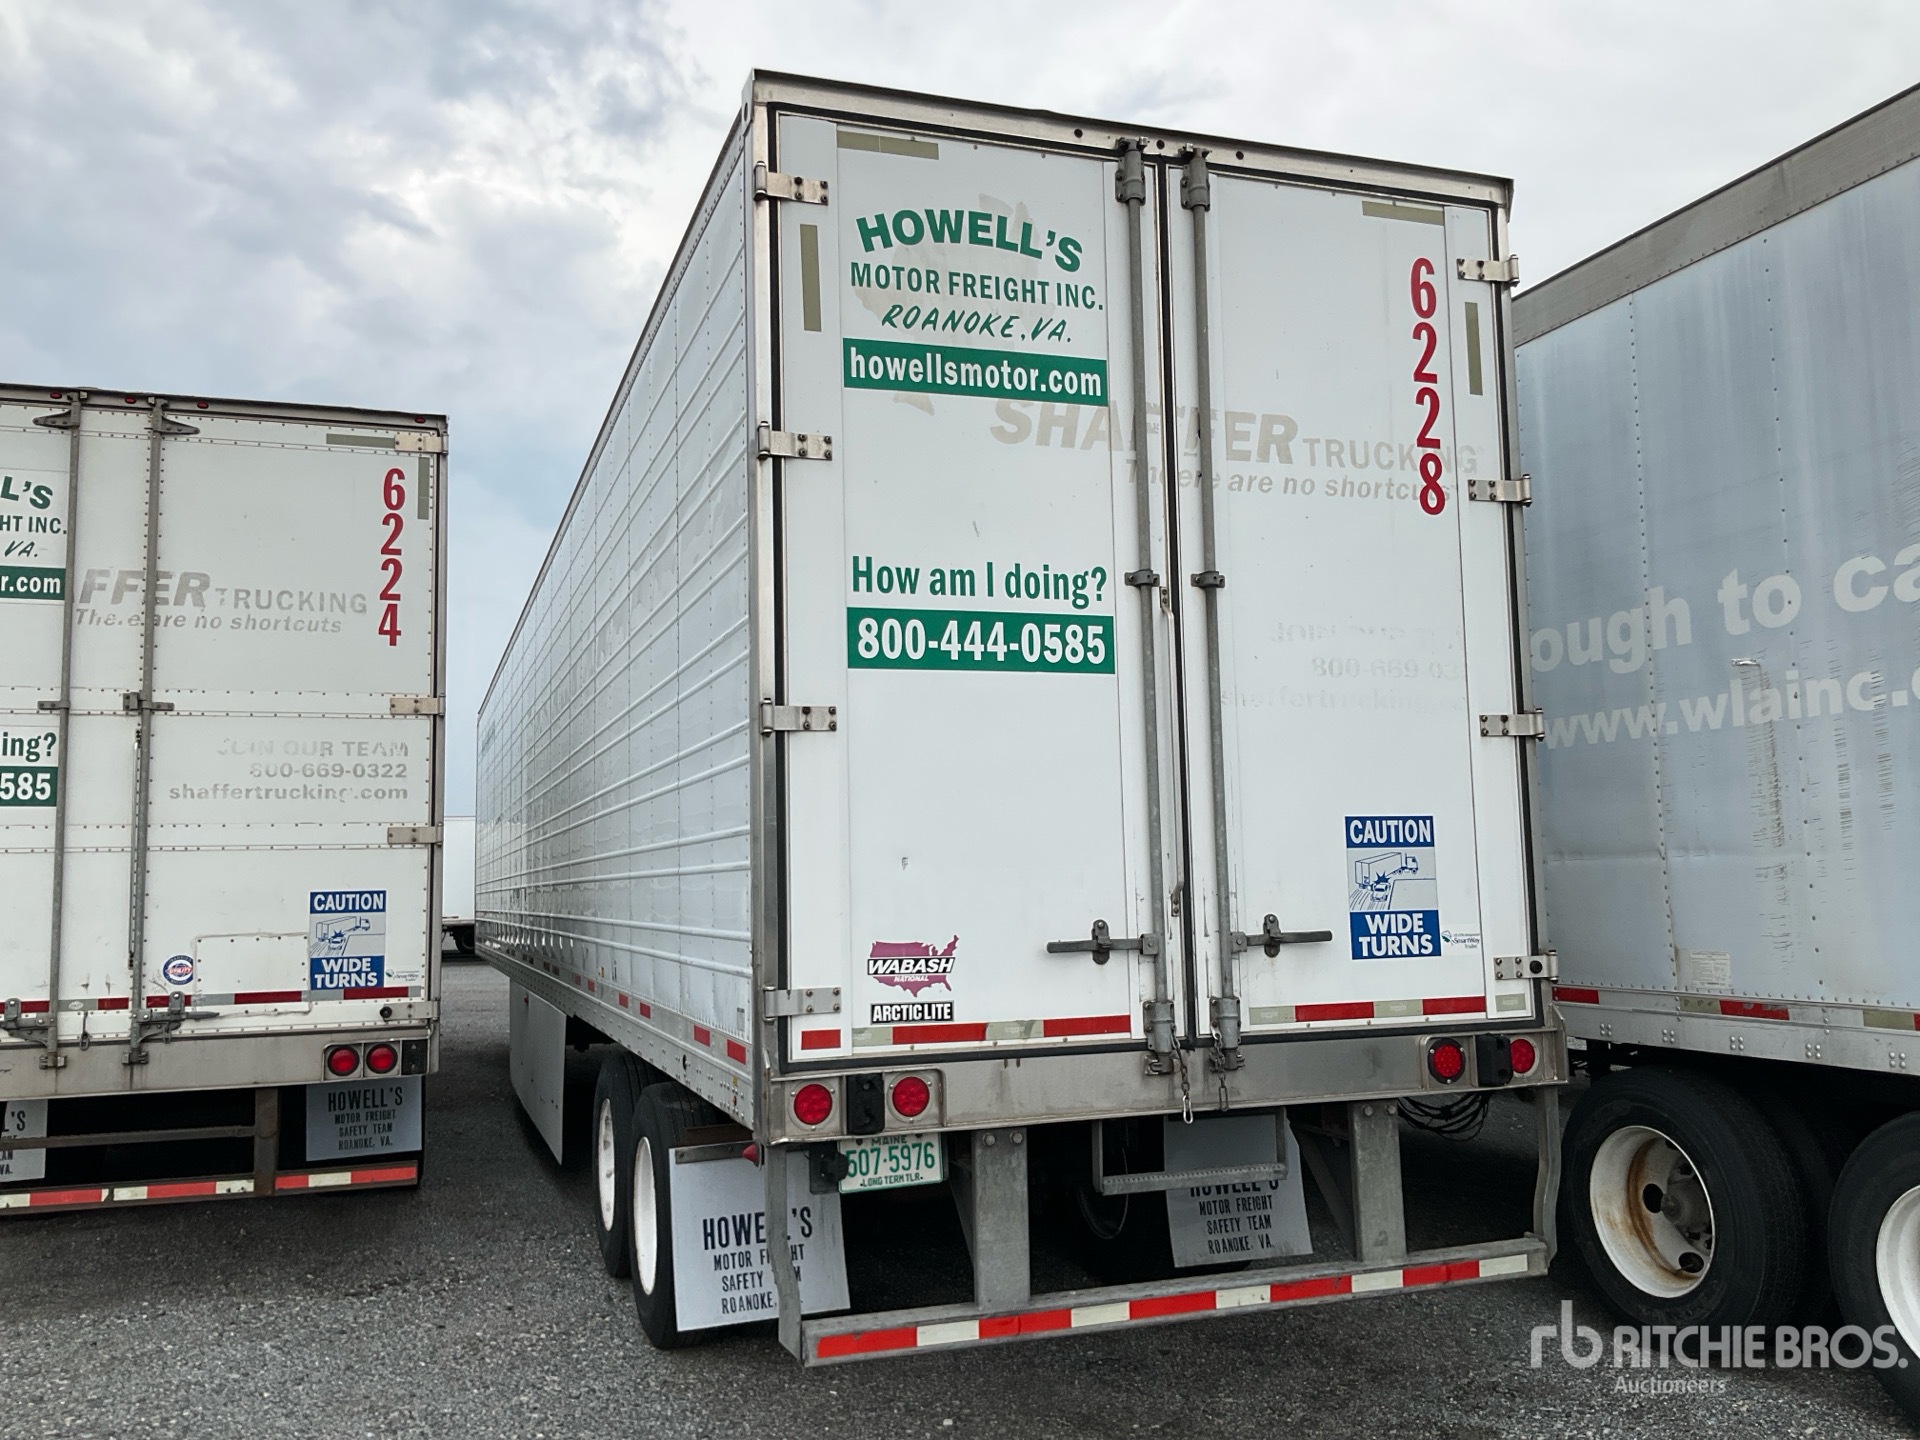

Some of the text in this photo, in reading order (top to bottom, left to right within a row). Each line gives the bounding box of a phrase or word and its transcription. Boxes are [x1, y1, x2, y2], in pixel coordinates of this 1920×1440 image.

[856, 208, 1083, 272] HOWELL'S
[850, 262, 1104, 310] MOTOR FREIGHT INC.
[849, 347, 1102, 397] howellsmotor.com
[1410, 257, 1446, 516] 6228
[1228, 472, 1275, 494] are
[1283, 476, 1316, 496] no
[28, 515, 68, 535] INC.
[378, 467, 407, 647] 6224
[852, 555, 1107, 610] How am I doing?
[215, 587, 368, 615] TRUCKING
[1717, 567, 1802, 636] to
[194, 613, 222, 629] no
[230, 614, 343, 635] shortcuts
[857, 617, 1106, 665] 800-444-0585
[342, 739, 409, 758] TEAM
[248, 762, 408, 779] 800-669-0322
[1350, 818, 1432, 845] CAUTION
[313, 893, 384, 911] CAUTION
[1365, 912, 1425, 935] WIDE
[1358, 934, 1434, 958] TURNS
[321, 957, 371, 973] WIDE
[868, 958, 954, 974] WABASH
[314, 972, 378, 988] TURNS
[872, 1003, 951, 1022] ARCTIC LITE
[328, 1086, 403, 1112] HOWELL'S
[334, 1109, 397, 1125] MOTOR FREIGHT
[339, 1122, 393, 1137] SAFETY TEAM
[871, 1135, 908, 1146] MAINE
[862, 1176, 883, 1188] LONG
[884, 1174, 904, 1185] TERM
[1199, 1194, 1273, 1216] MOTOR FREIGHT
[702, 1206, 813, 1251] HOWE'S
[1206, 1214, 1272, 1236] SAFETY TEAM
[713, 1250, 753, 1272] MOTOR
[721, 1270, 764, 1293] SAFETY
